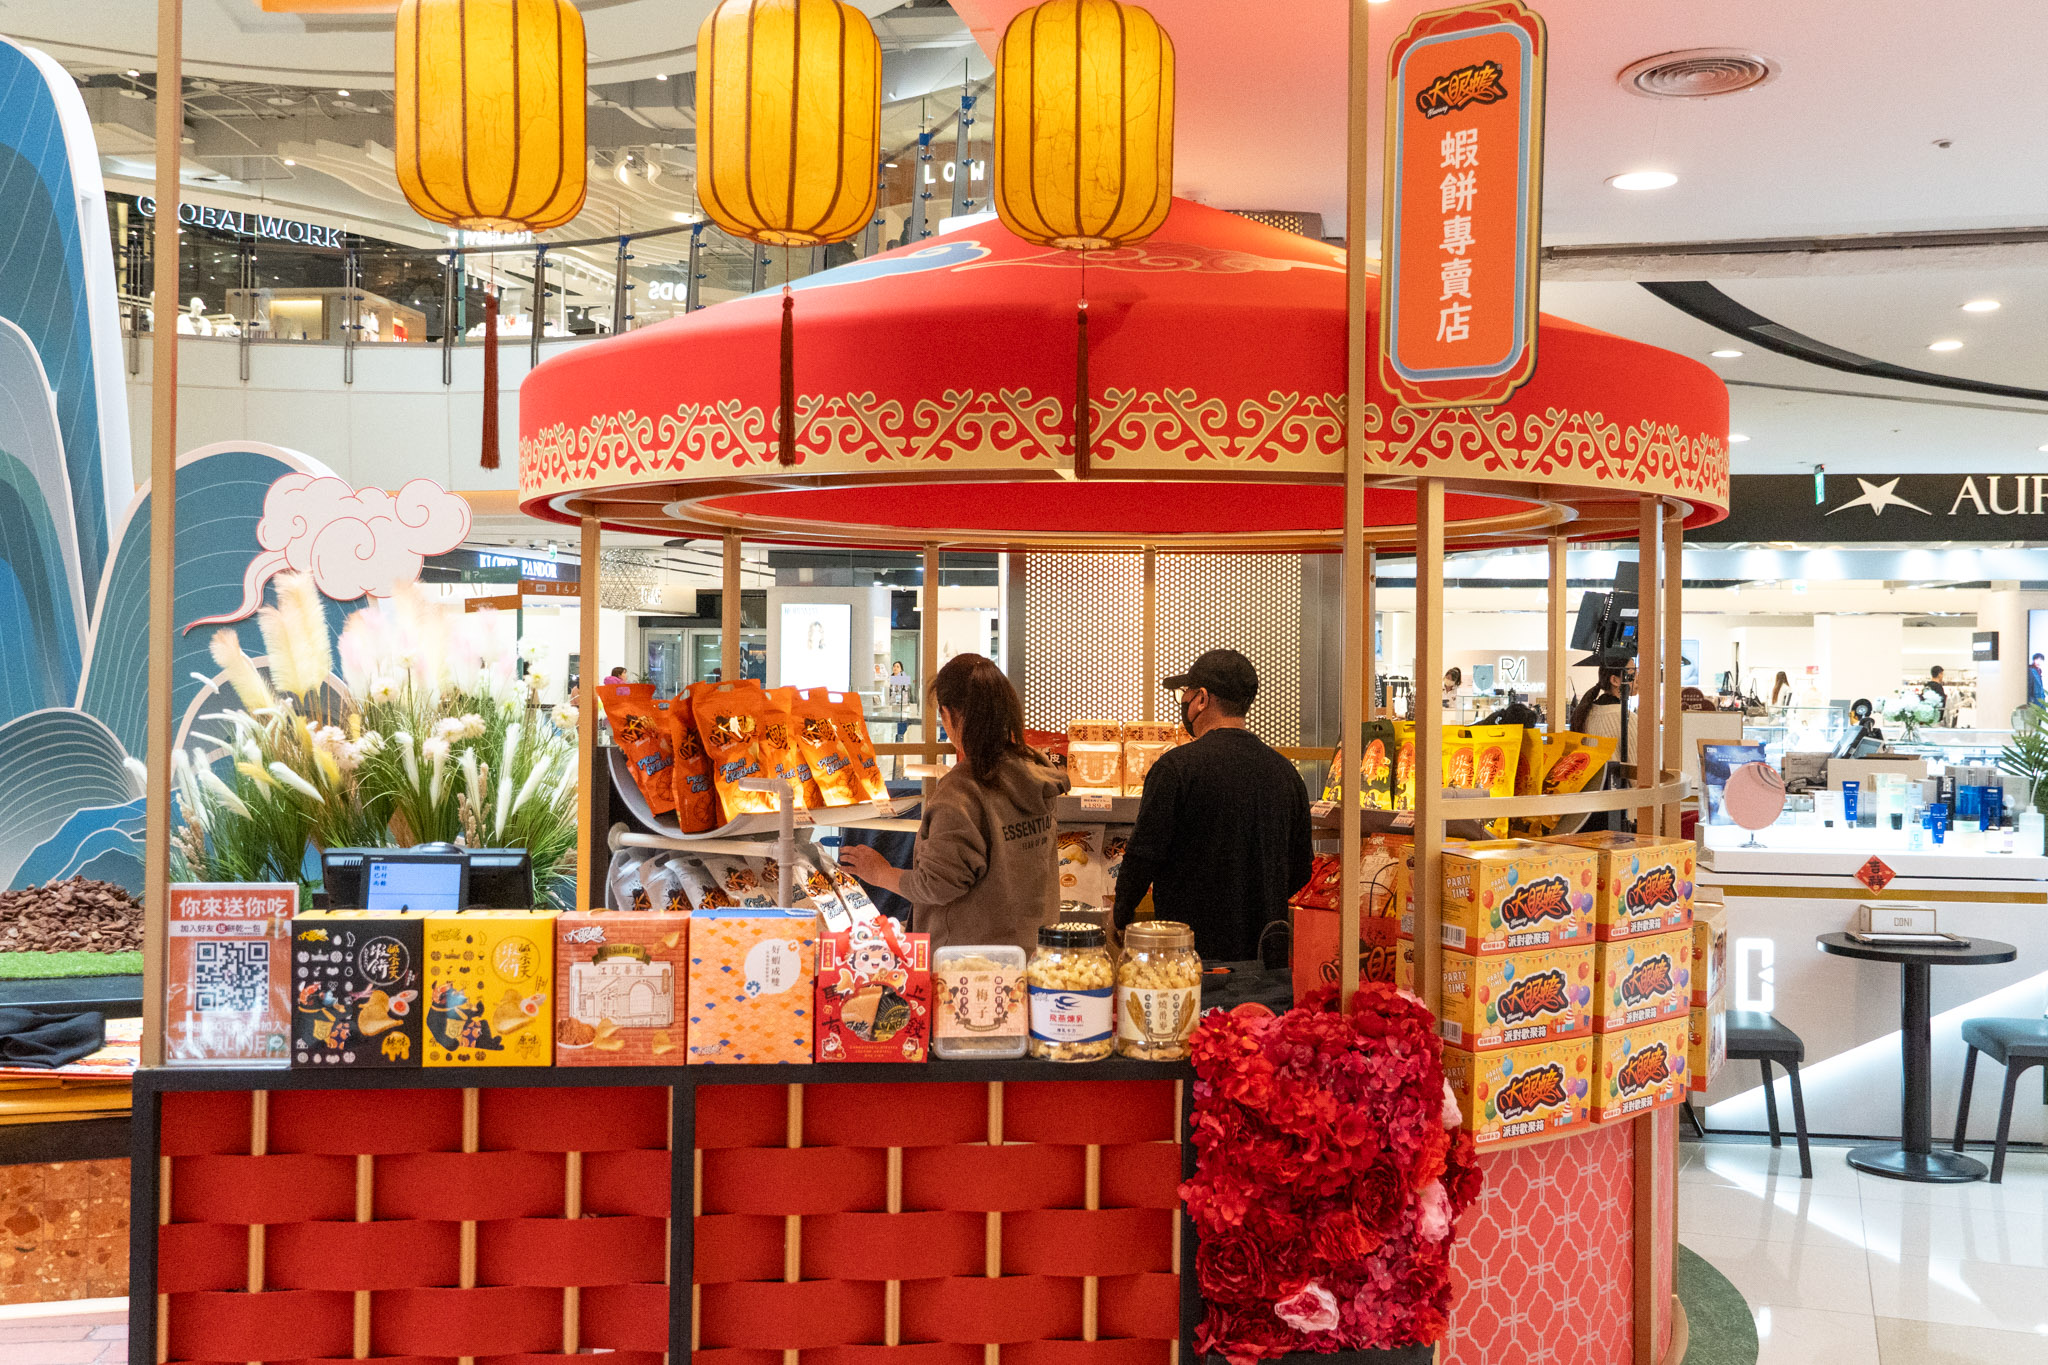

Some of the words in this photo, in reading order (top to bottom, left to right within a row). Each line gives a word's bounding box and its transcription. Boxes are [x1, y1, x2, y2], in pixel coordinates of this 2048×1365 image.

[136, 195, 256, 236] GOBAL
[257, 213, 342, 249] WORK
[1436, 128, 1479, 343] 蝦餅專賣店
[1446, 875, 1471, 888] PARTY
[1452, 887, 1470, 899] TIME
[179, 896, 288, 918] 你來送你吃
[1443, 970, 1467, 982] PARTY
[1448, 981, 1466, 994] TIME
[1447, 1078, 1465, 1089] IME
